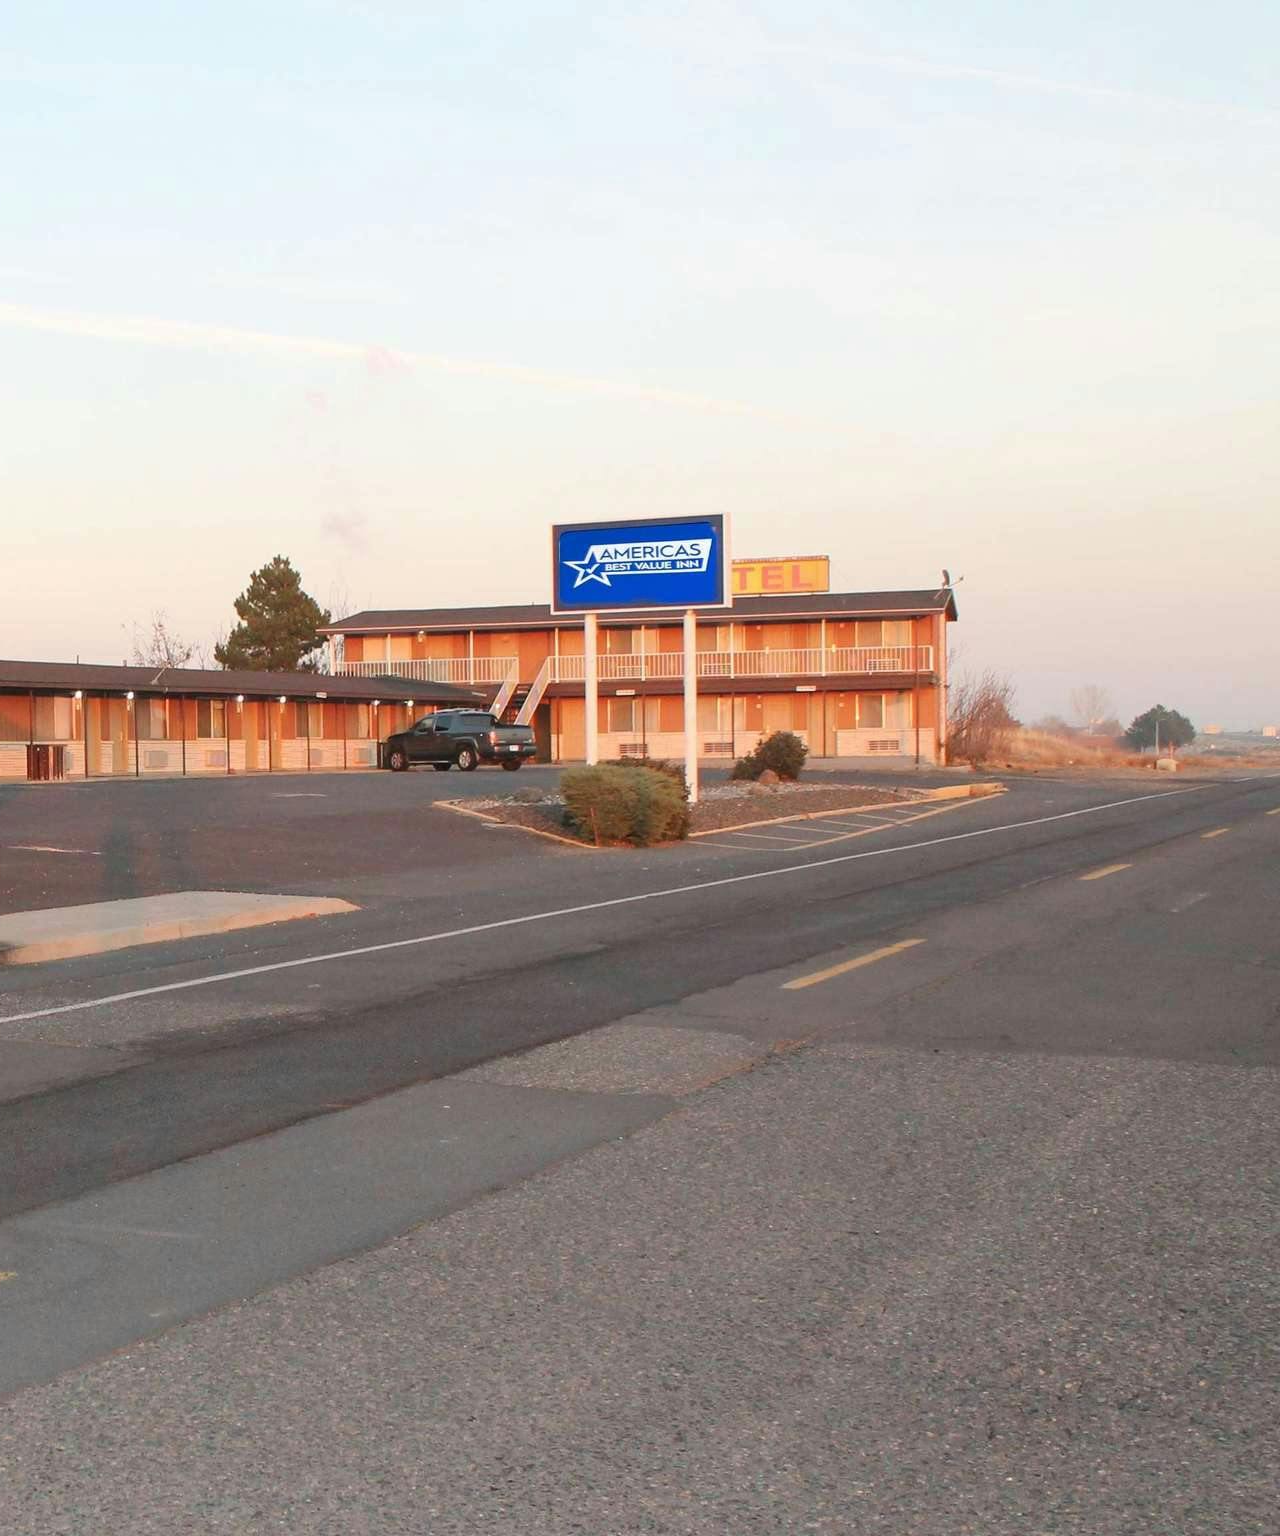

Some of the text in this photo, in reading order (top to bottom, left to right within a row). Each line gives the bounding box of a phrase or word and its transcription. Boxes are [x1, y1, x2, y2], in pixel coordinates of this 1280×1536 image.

[600, 543, 701, 560] AMERICAS
[604, 559, 700, 571] BEST VALUE INN
[732, 564, 812, 591] TEL
